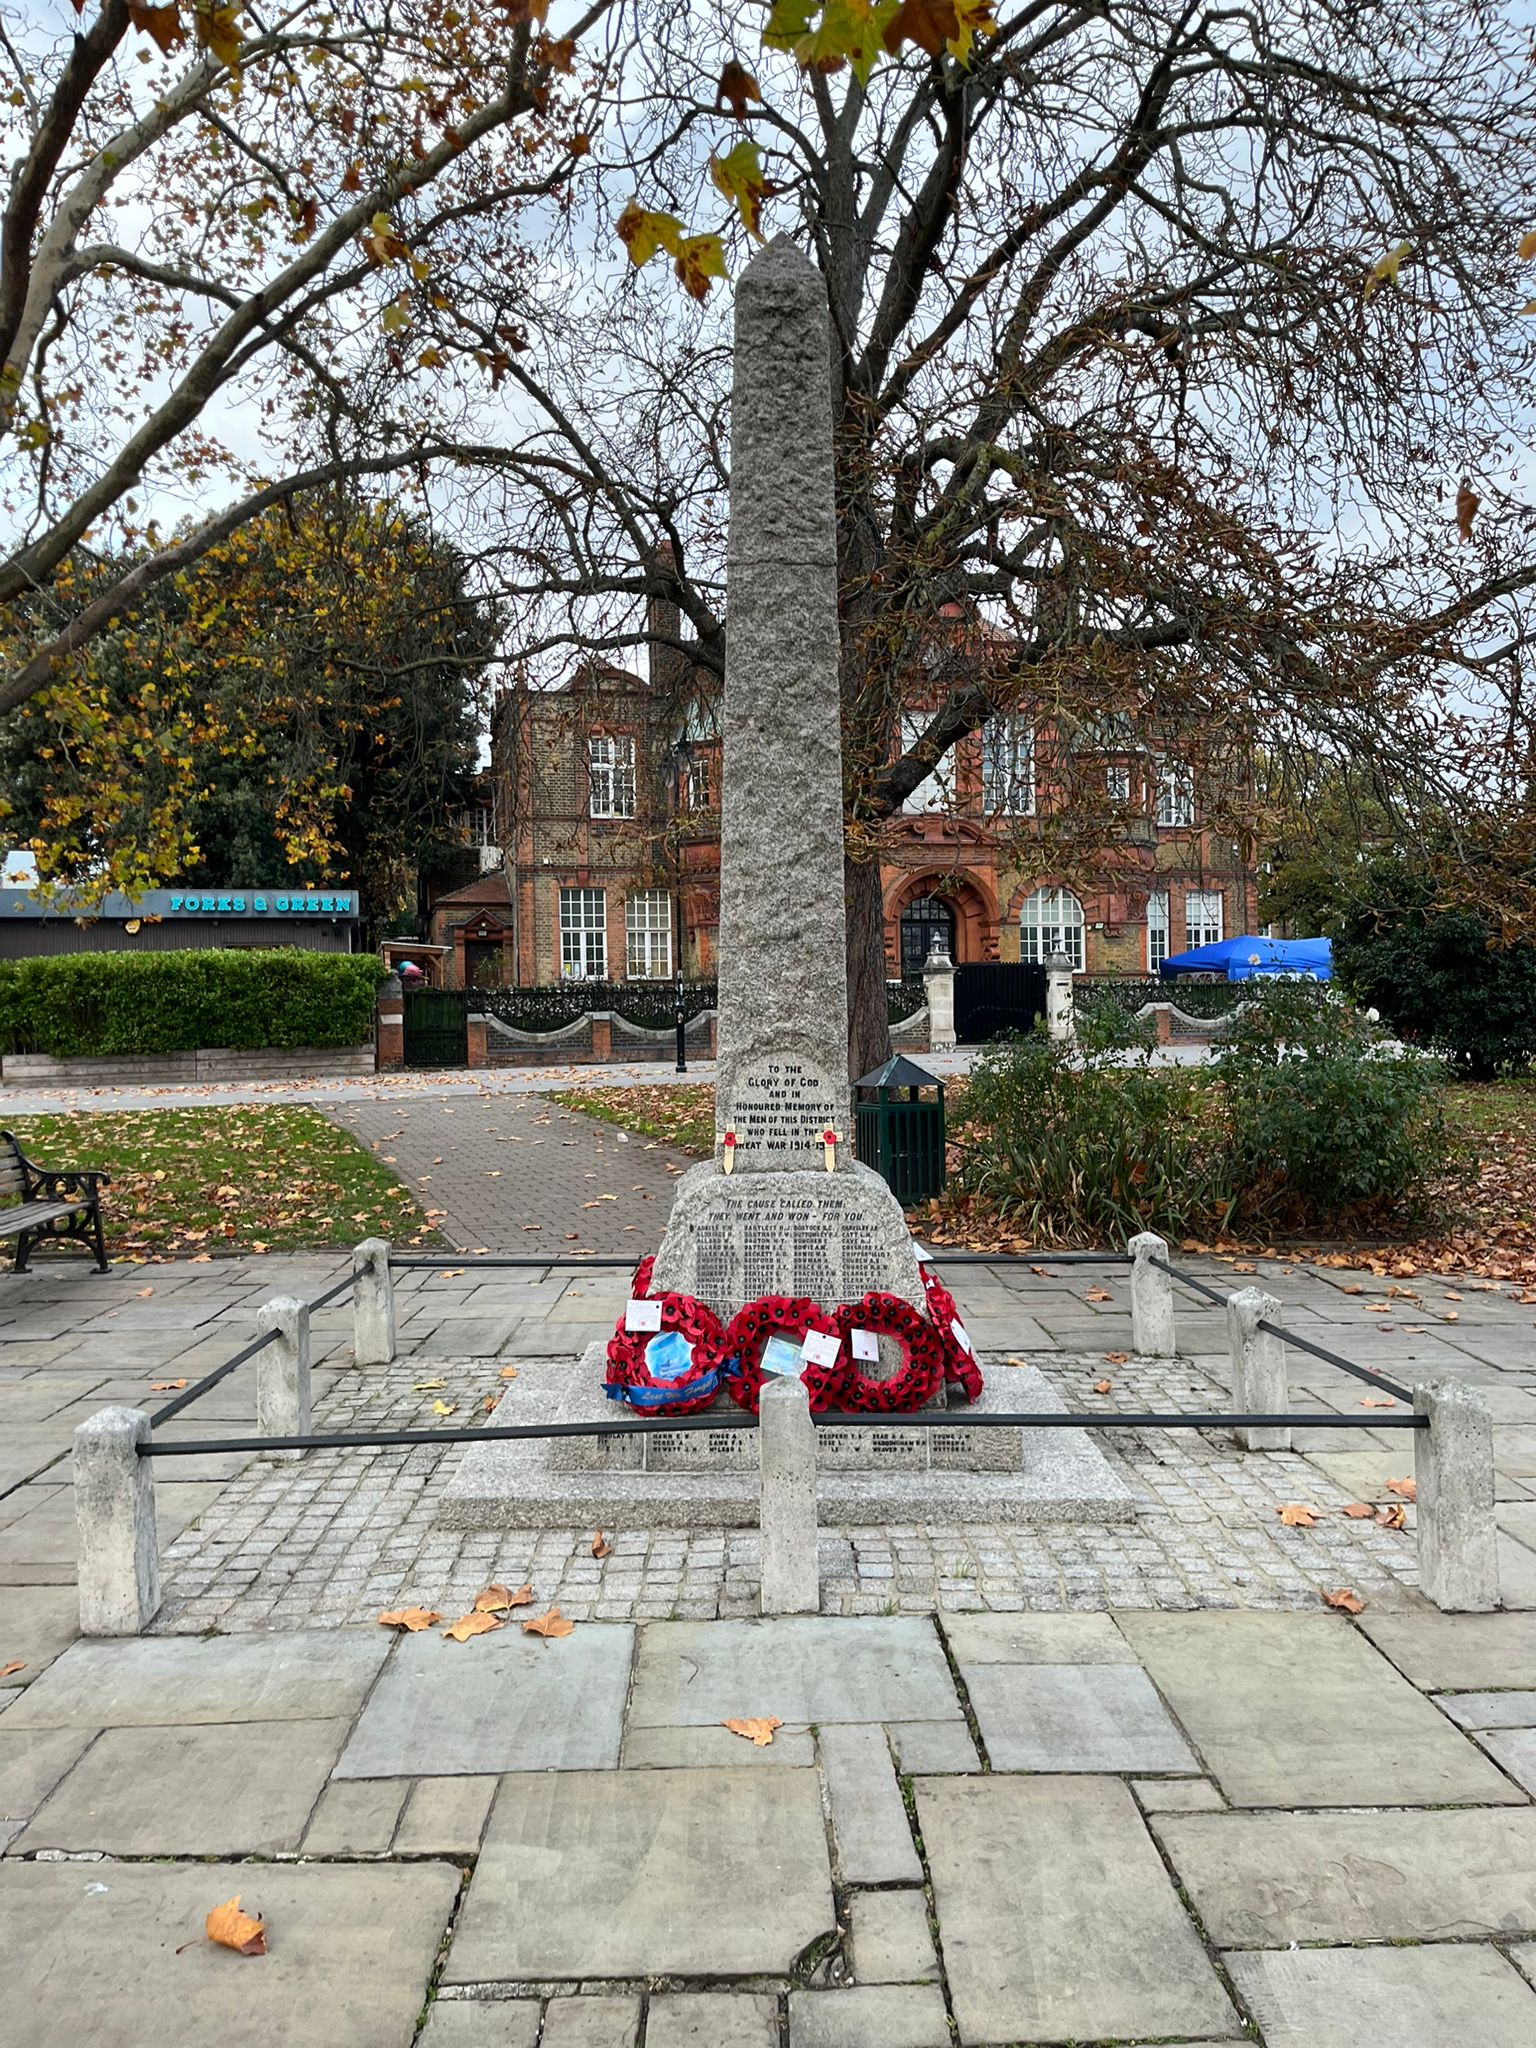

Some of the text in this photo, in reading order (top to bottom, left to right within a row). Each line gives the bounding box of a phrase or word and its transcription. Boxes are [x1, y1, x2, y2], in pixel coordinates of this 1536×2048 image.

[171, 897, 351, 911] FORKS & GREEN
[769, 1065, 779, 1073] TO
[748, 1077, 819, 1087] GLORY OF GOD
[736, 1103, 834, 1111] HONOURED MEMORY OF
[749, 1115, 766, 1123] MEN
[800, 1115, 835, 1123] DISTRICT
[767, 1141, 786, 1150] WAR
[727, 1200, 743, 1208] THE
[747, 1200, 777, 1208] CAUSE
[780, 1200, 813, 1208] CALLED
[736, 1212, 761, 1220] WENT
[764, 1212, 784, 1220] AND
[788, 1212, 809, 1220] WON
[822, 1212, 840, 1220] FOR
[641, 1391, 664, 1400] Lest
